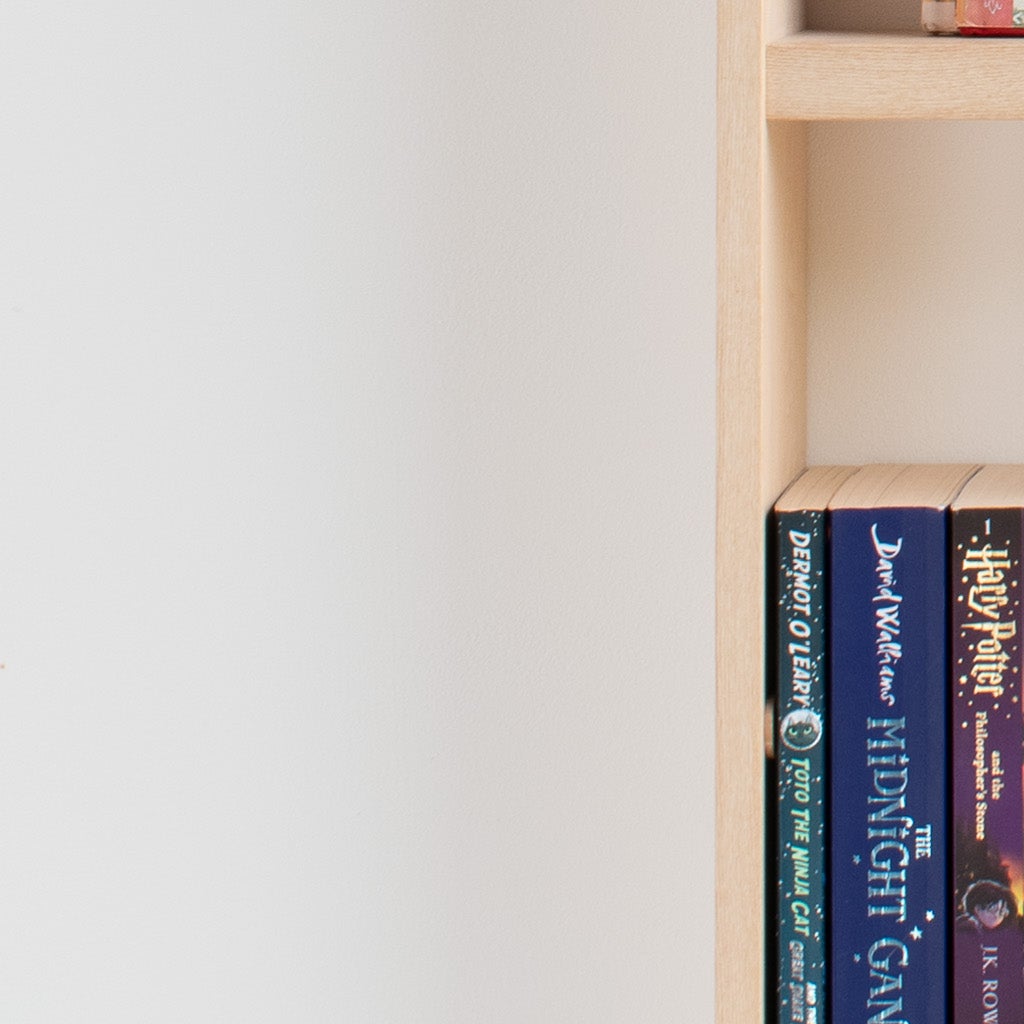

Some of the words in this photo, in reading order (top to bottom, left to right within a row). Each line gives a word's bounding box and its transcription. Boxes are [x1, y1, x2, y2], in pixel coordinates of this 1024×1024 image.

[789, 530, 811, 616] DERMOT
[871, 523, 903, 602] David
[962, 544, 1011, 620] Harry
[788, 619, 812, 706] O'LEARY
[961, 620, 1016, 697] Potter
[972, 711, 988, 800] Philosopher's
[991, 750, 1005, 776] and
[790, 757, 810, 803] TOTO
[991, 778, 1005, 800] the
[790, 808, 811, 843] THE
[915, 824, 932, 859] THE
[975, 802, 988, 841] Stone
[790, 846, 811, 896] NINJA
[790, 901, 811, 936] CAT
